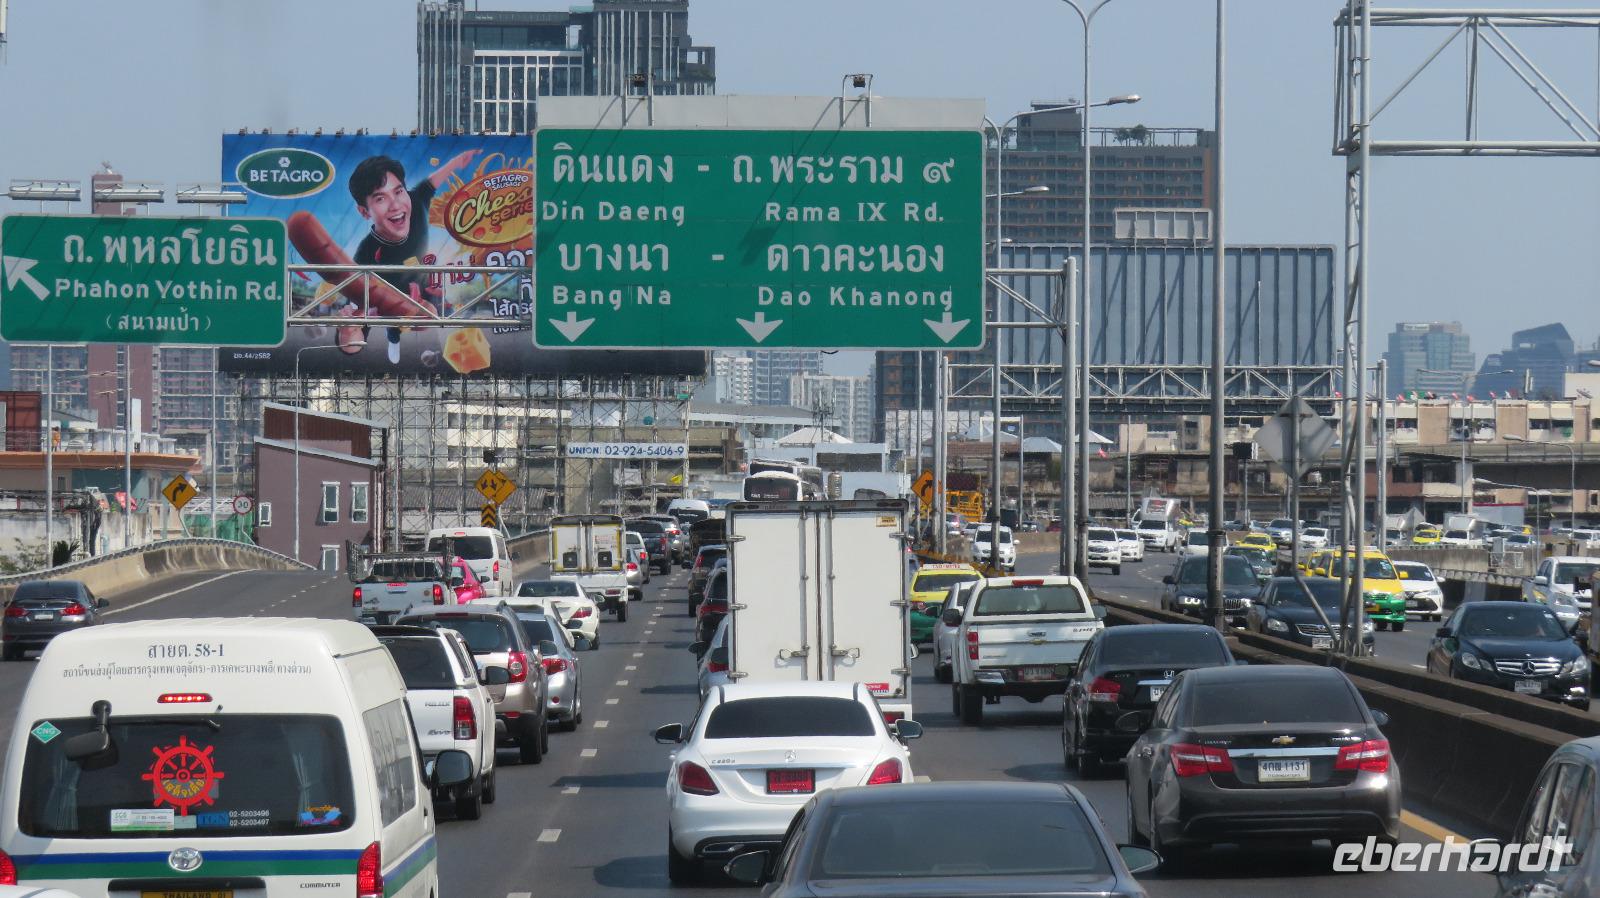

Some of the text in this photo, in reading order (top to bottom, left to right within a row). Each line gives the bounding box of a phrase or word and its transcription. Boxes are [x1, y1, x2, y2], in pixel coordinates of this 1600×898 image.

[553, 142, 673, 183] ดินแดง
[250, 169, 324, 183] BETAGRO
[484, 174, 529, 187] BETAGRO
[542, 201, 685, 227] Din Daeng
[765, 202, 944, 222] Rama IX Rd.
[558, 243, 670, 271] บางนา
[767, 244, 944, 273] ดาวคะนอง
[55, 278, 282, 301] Phahon Yothin Rd.
[553, 285, 623, 311] Bang
[637, 285, 671, 305] Na
[758, 286, 953, 312] Dao Khanong
[194, 643, 225, 658] 58-1
